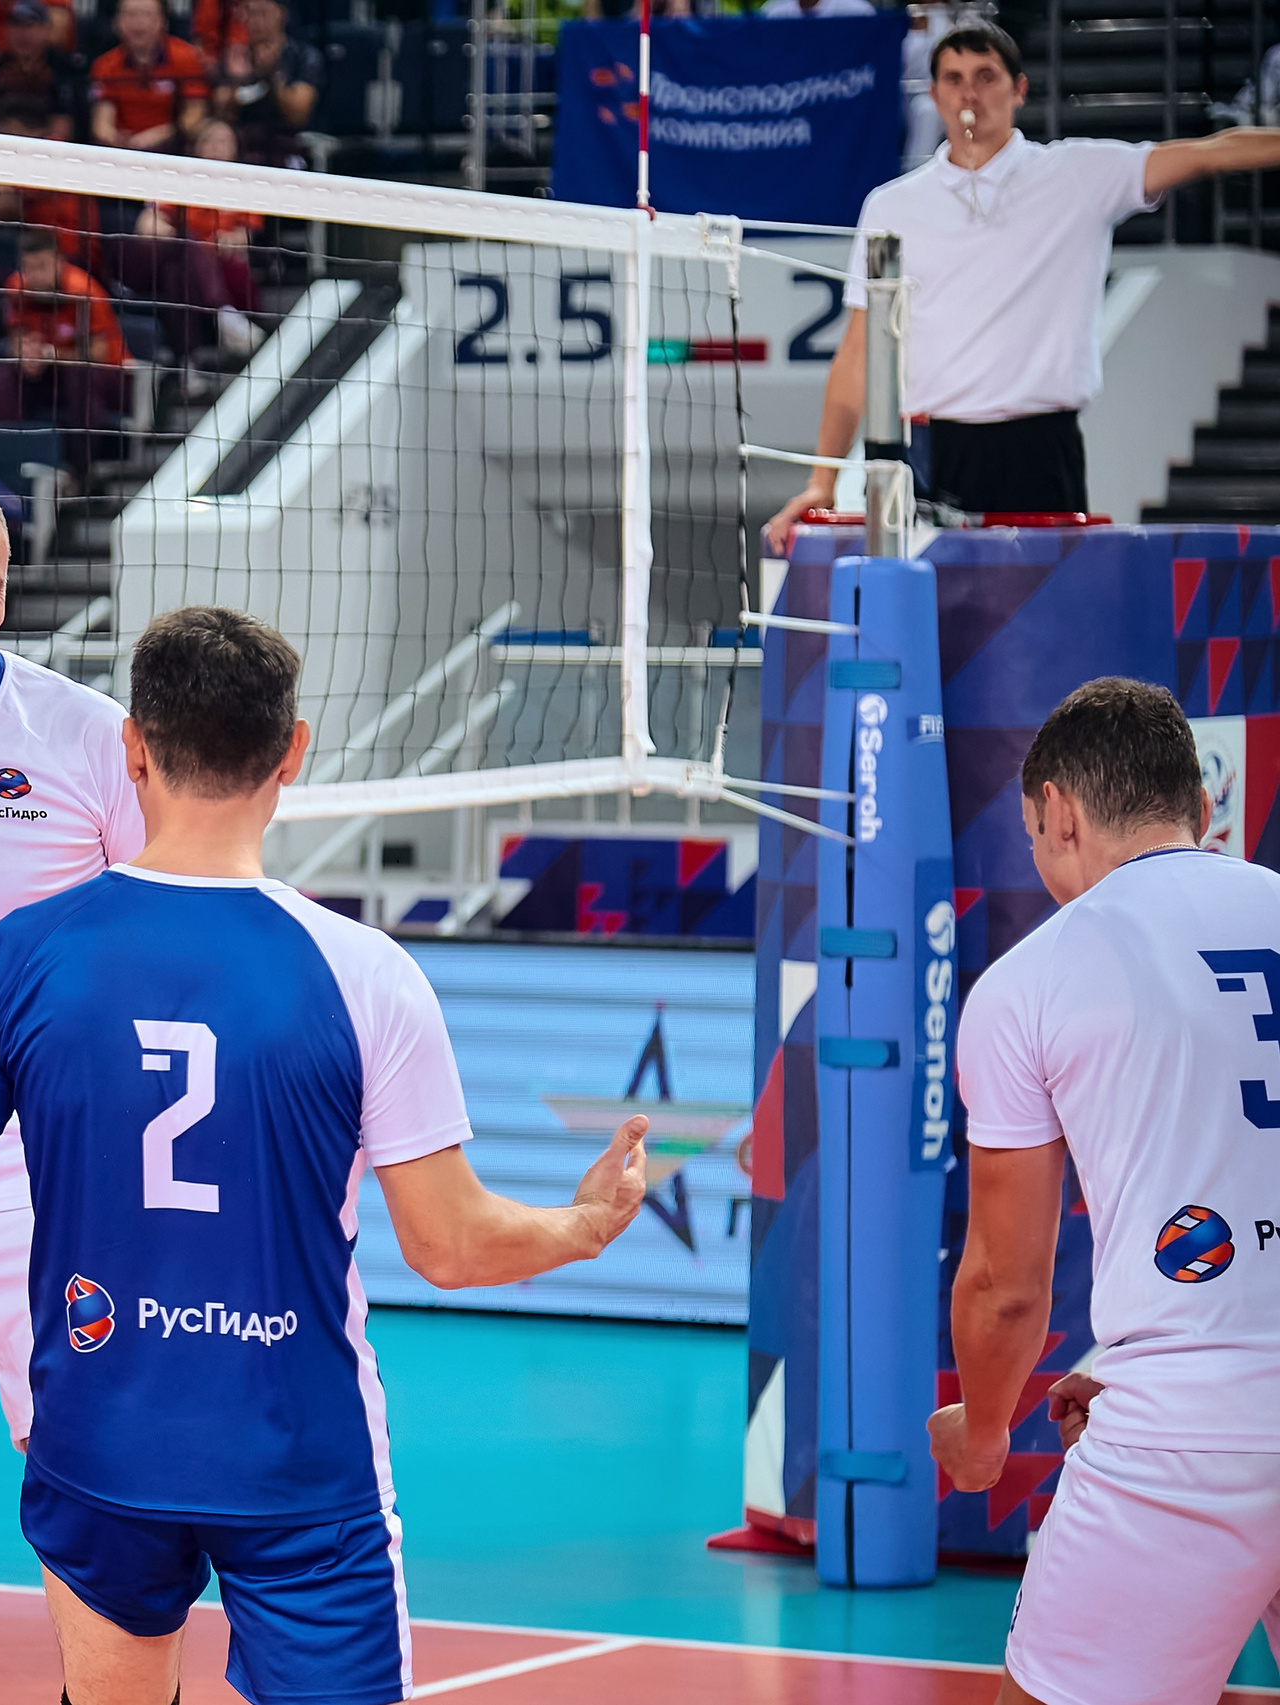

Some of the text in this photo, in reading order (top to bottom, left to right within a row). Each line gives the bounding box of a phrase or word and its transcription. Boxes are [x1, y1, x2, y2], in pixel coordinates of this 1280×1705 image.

[133, 1019, 220, 1213] 2
[921, 959, 954, 1161] Senoh
[1197, 948, 1280, 1129] 3
[138, 1297, 299, 1347] РусГидро
